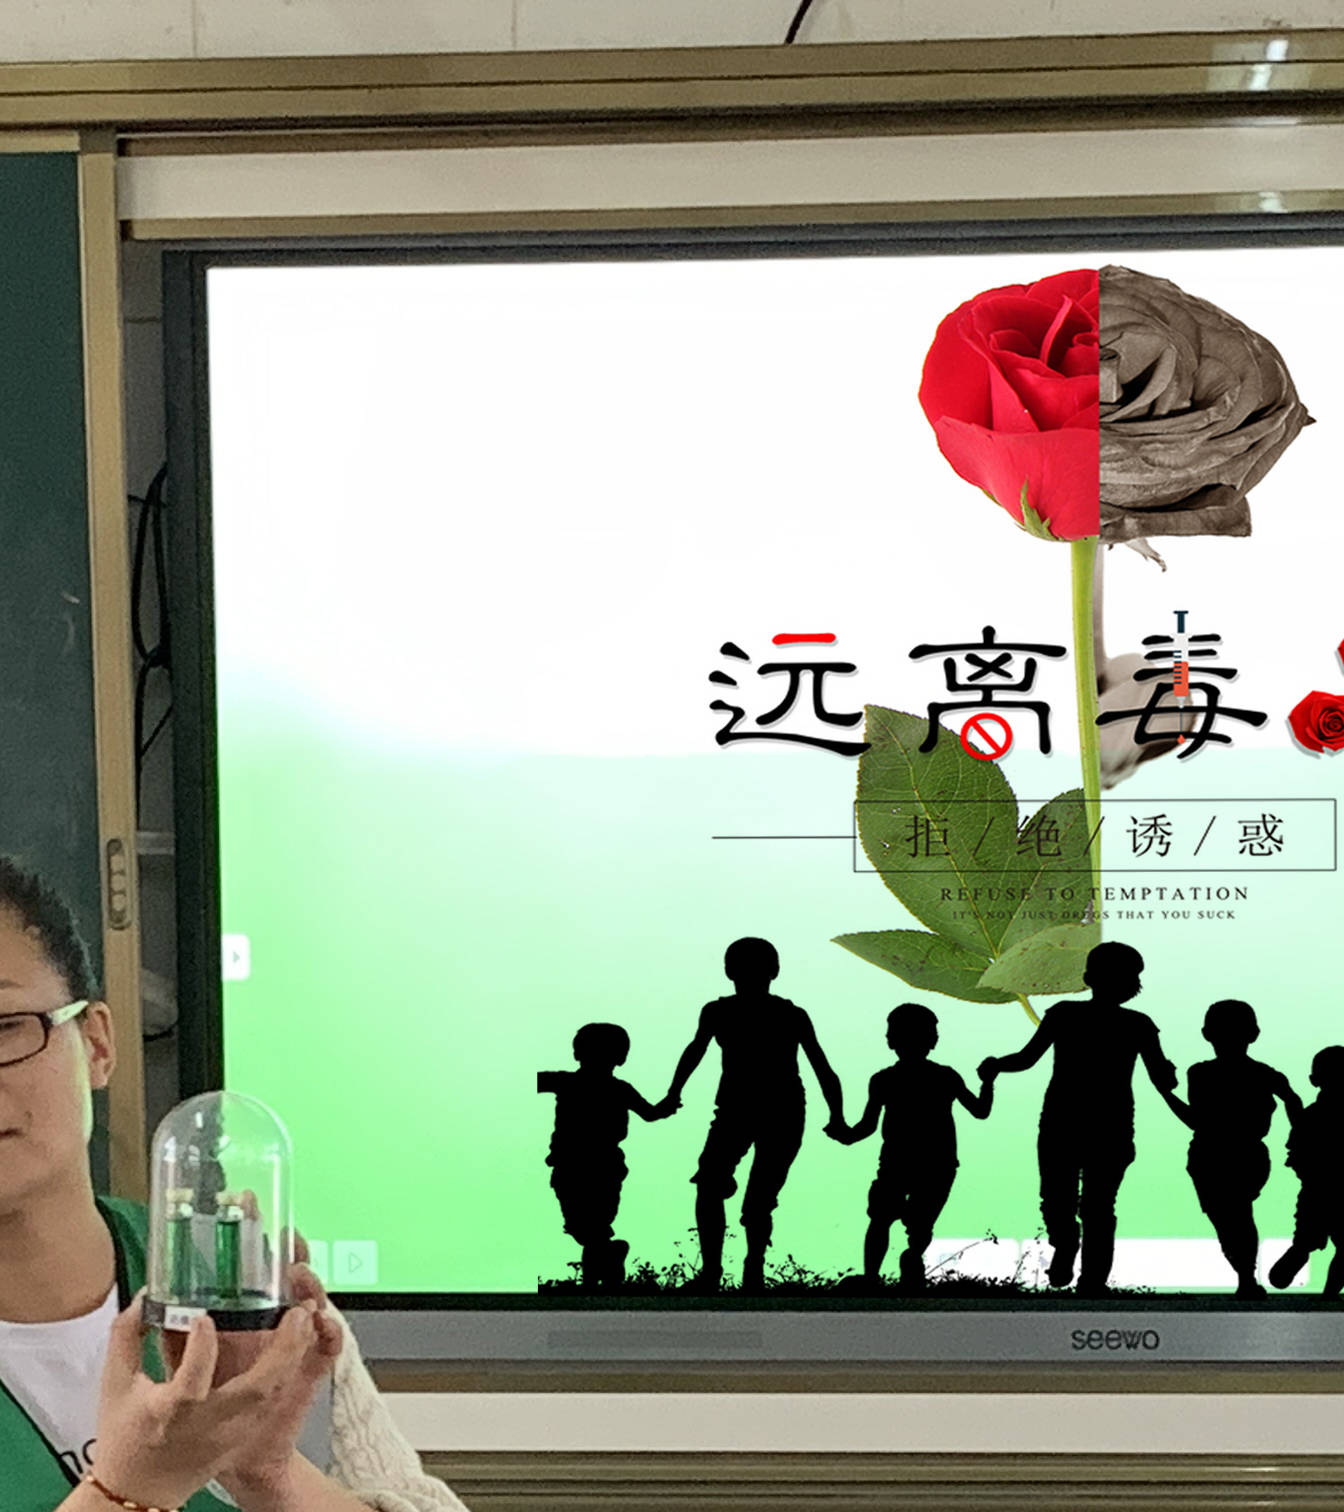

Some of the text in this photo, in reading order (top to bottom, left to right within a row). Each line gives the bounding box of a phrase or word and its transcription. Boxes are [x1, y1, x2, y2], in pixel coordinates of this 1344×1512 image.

[940, 886, 1250, 901] REFUSE TO TEMPTATION
[1117, 910, 1155, 920] THAT
[1162, 910, 1193, 920] YOU
[1199, 910, 1236, 920] SUCK
[1071, 1329, 1160, 1350] seewo
